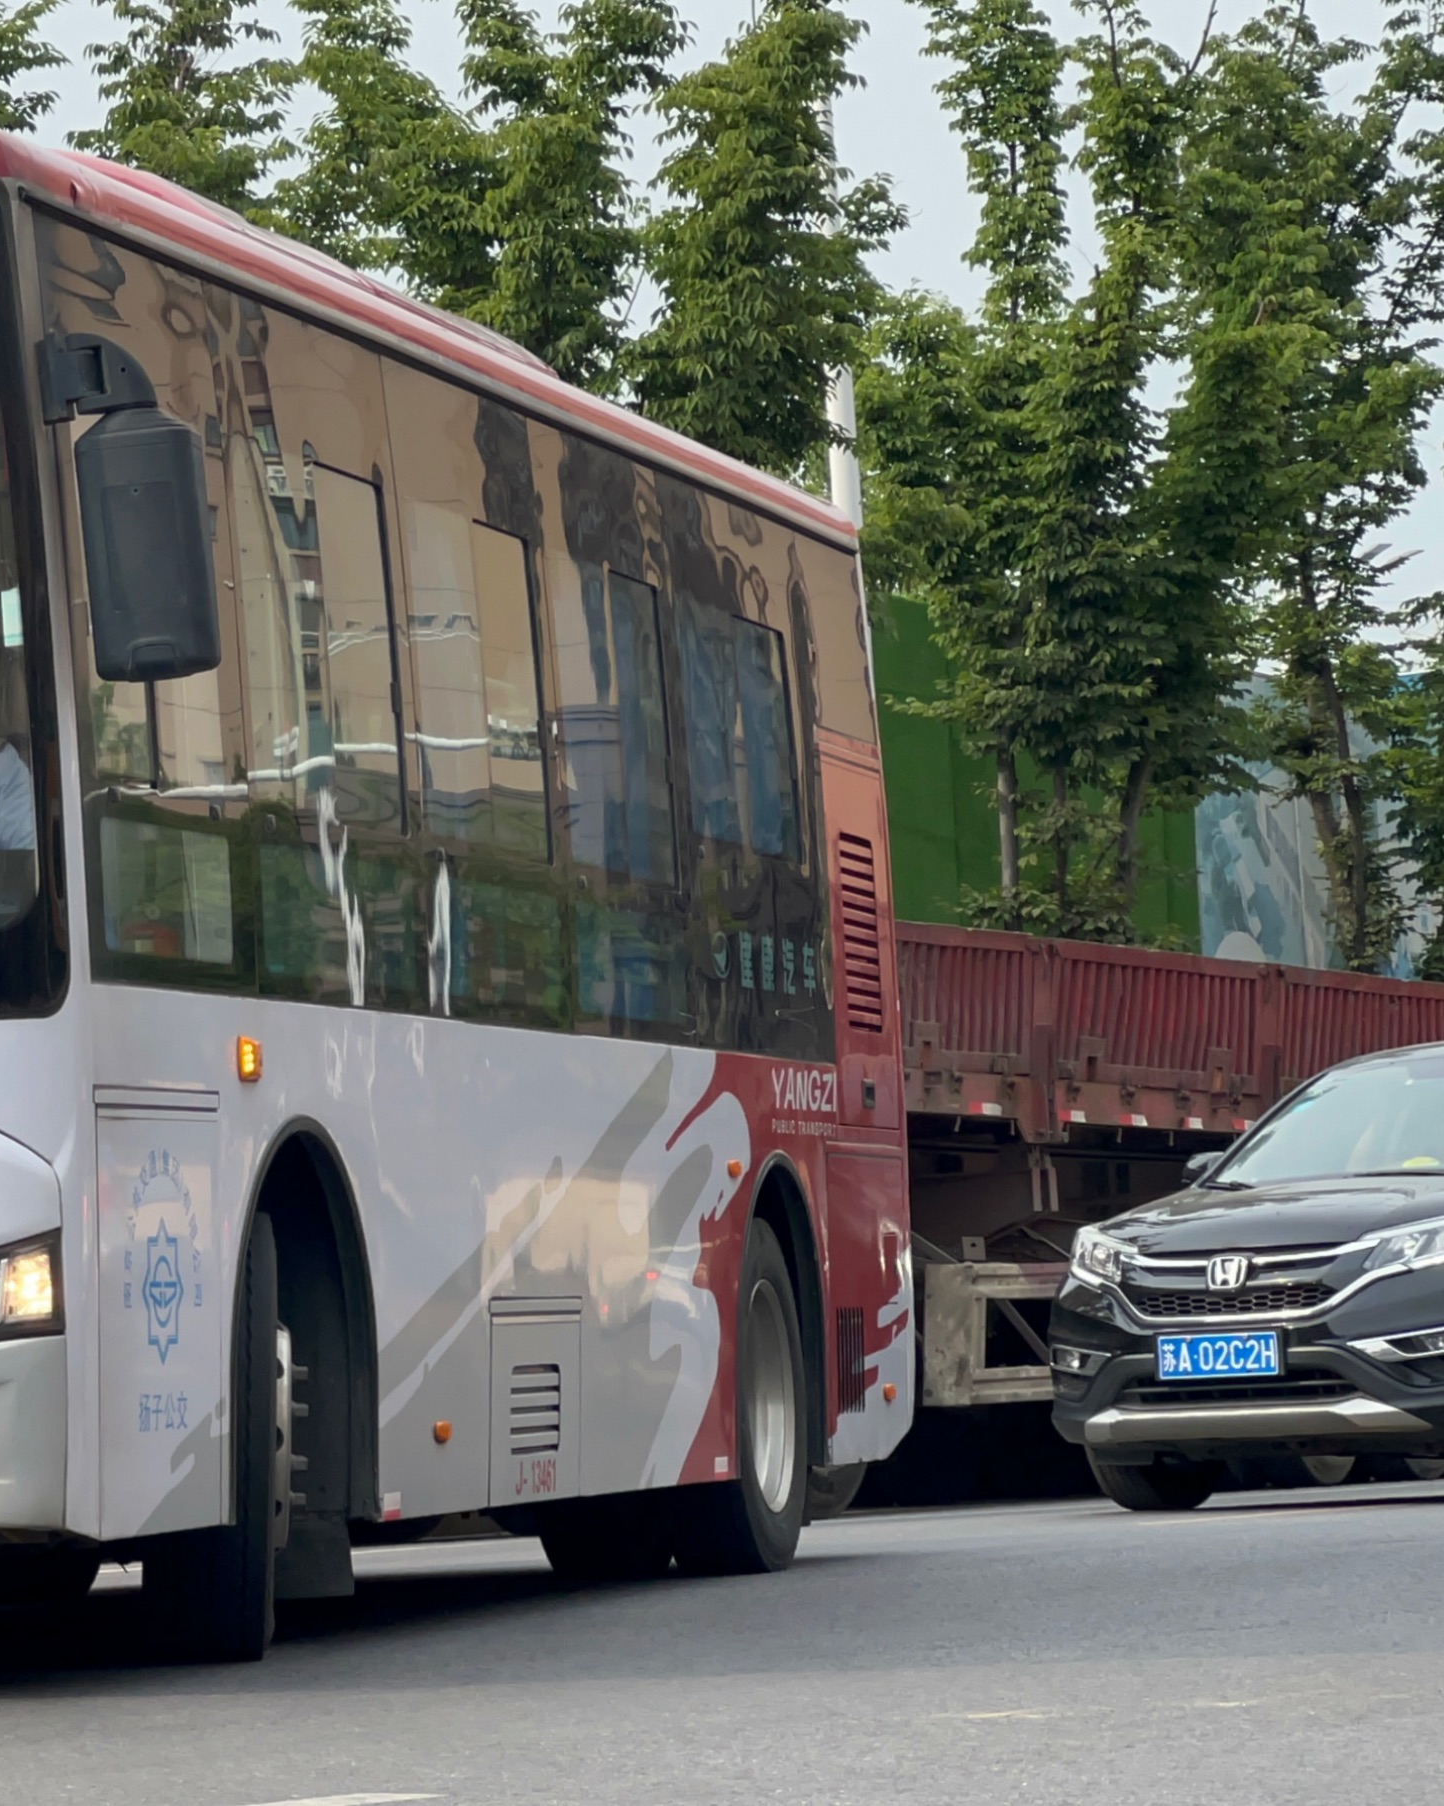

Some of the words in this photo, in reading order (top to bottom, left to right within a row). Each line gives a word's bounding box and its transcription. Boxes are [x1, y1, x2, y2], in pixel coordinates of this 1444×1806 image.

[771, 1066, 837, 1113] YANGZI
[771, 1117, 796, 1135] PUBLIC
[798, 1120, 837, 1138] TRANSPORT
[531, 1458, 557, 1494] 13461
